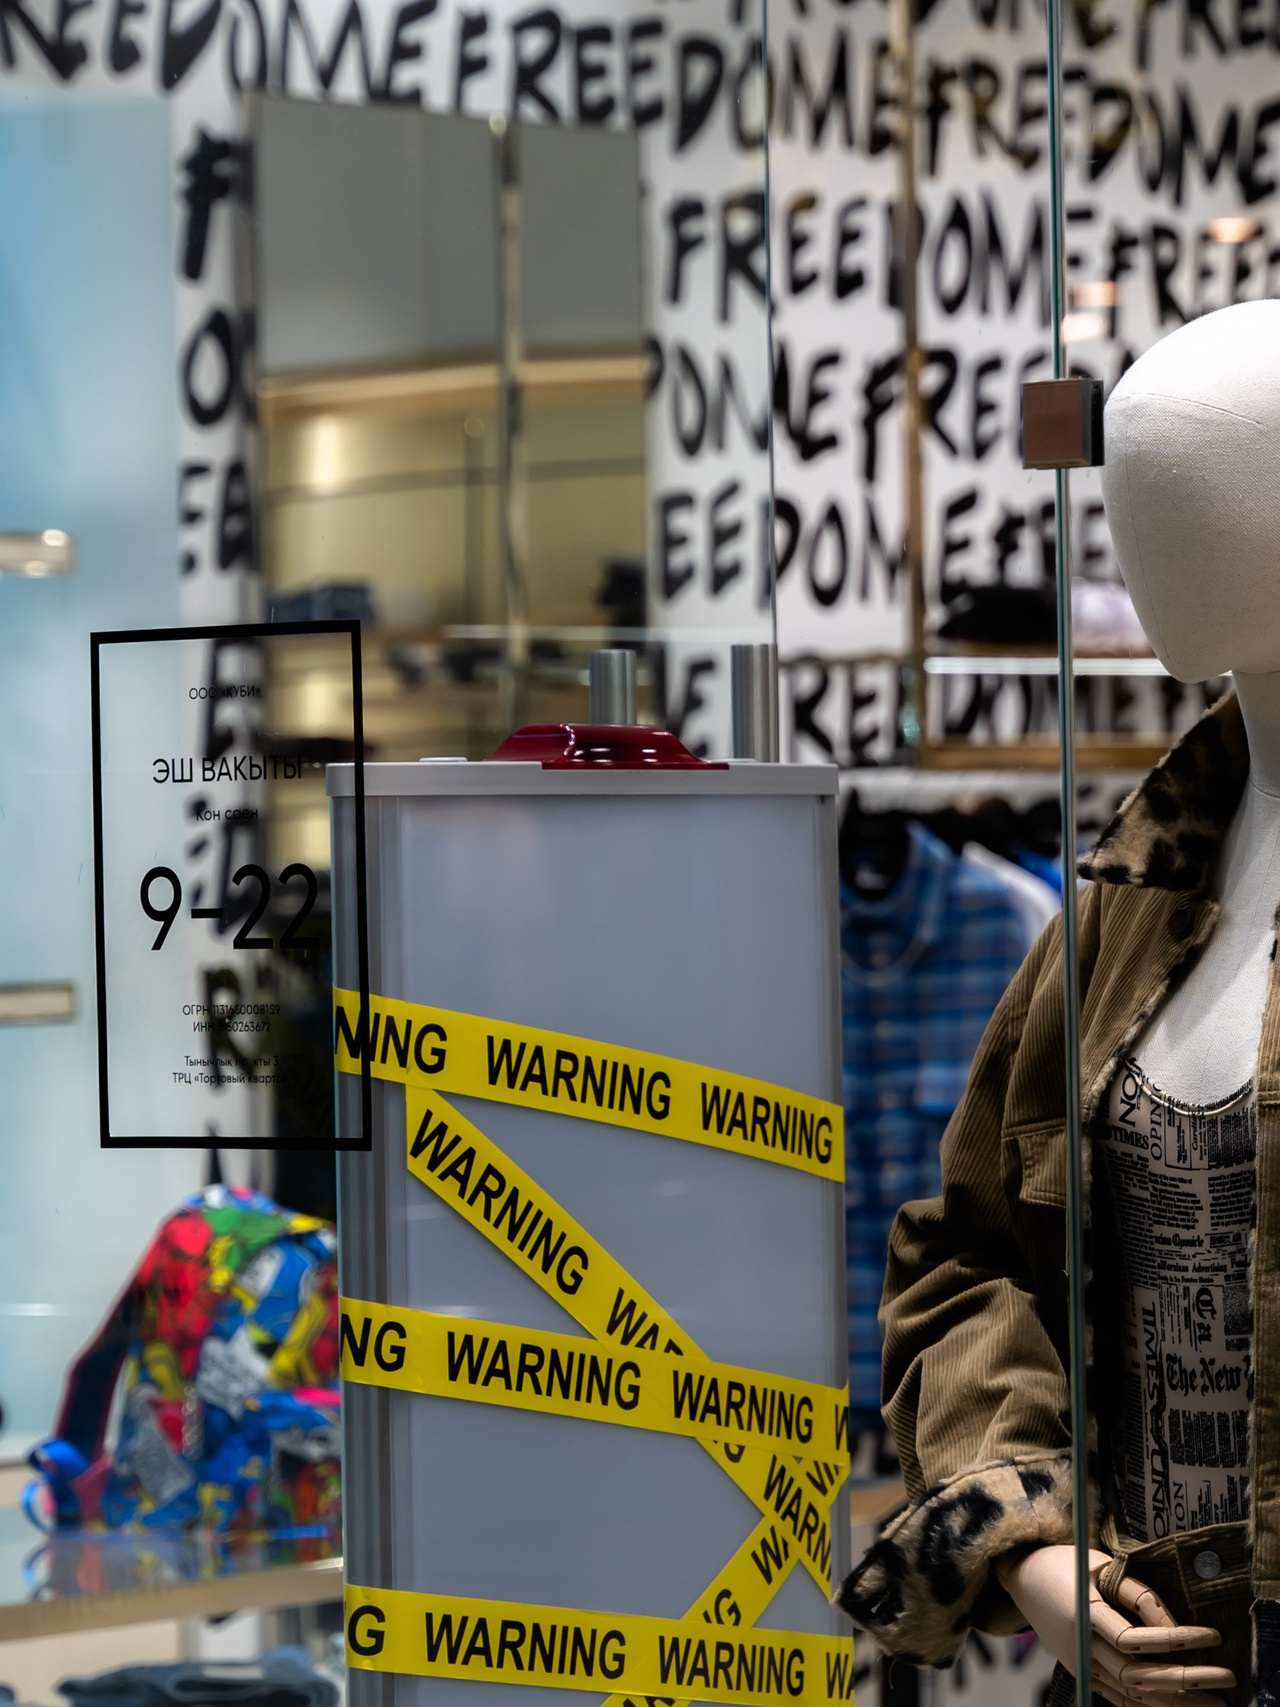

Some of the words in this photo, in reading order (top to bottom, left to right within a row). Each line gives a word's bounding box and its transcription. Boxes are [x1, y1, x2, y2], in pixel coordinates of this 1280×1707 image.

[188, 687, 217, 700] ООО
[152, 757, 193, 783] ЭШ
[202, 754, 302, 782] ВАКЫТЫ
[224, 808, 258, 821] саен
[172, 1072, 192, 1085] ТРЦ
[486, 1034, 672, 1121] WARNING
[700, 1081, 833, 1166] WARNING
[408, 1108, 589, 1297] WARNING
[446, 1330, 642, 1411] WARNING
[672, 1368, 814, 1444] WARNING
[424, 1611, 626, 1681] WARNING
[658, 1635, 806, 1697] WARNING
